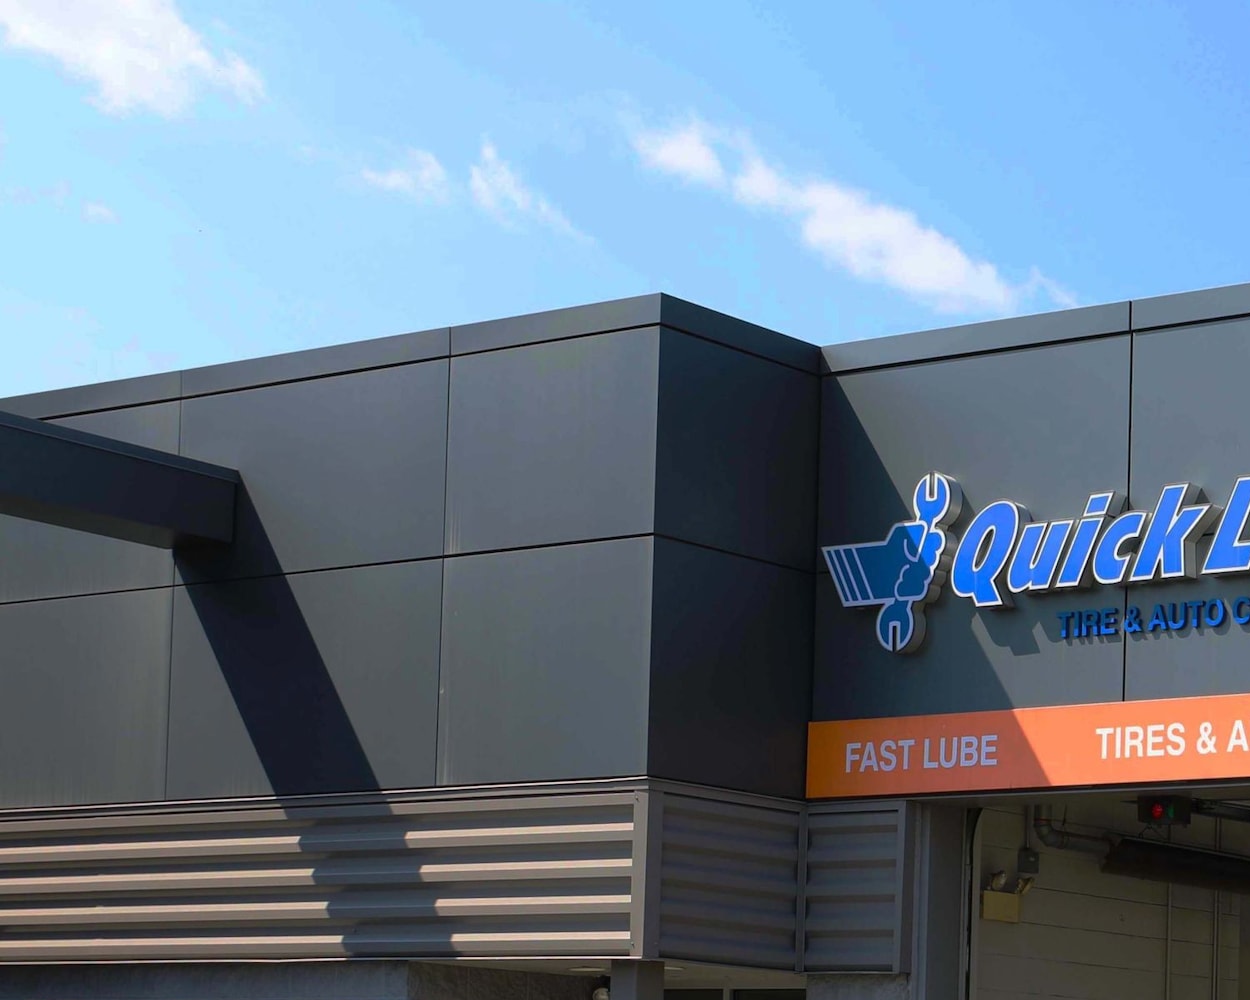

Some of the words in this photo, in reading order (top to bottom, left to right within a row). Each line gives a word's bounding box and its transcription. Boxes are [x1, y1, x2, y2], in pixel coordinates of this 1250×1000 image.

[951, 482, 1213, 607] Quick
[1056, 607, 1119, 639] TIRE
[1124, 605, 1142, 634] &
[1148, 598, 1228, 632] AUTO
[845, 739, 915, 773] FAST
[923, 735, 998, 769] LUBE
[1096, 722, 1186, 759] TIRES
[1196, 721, 1217, 755] &
